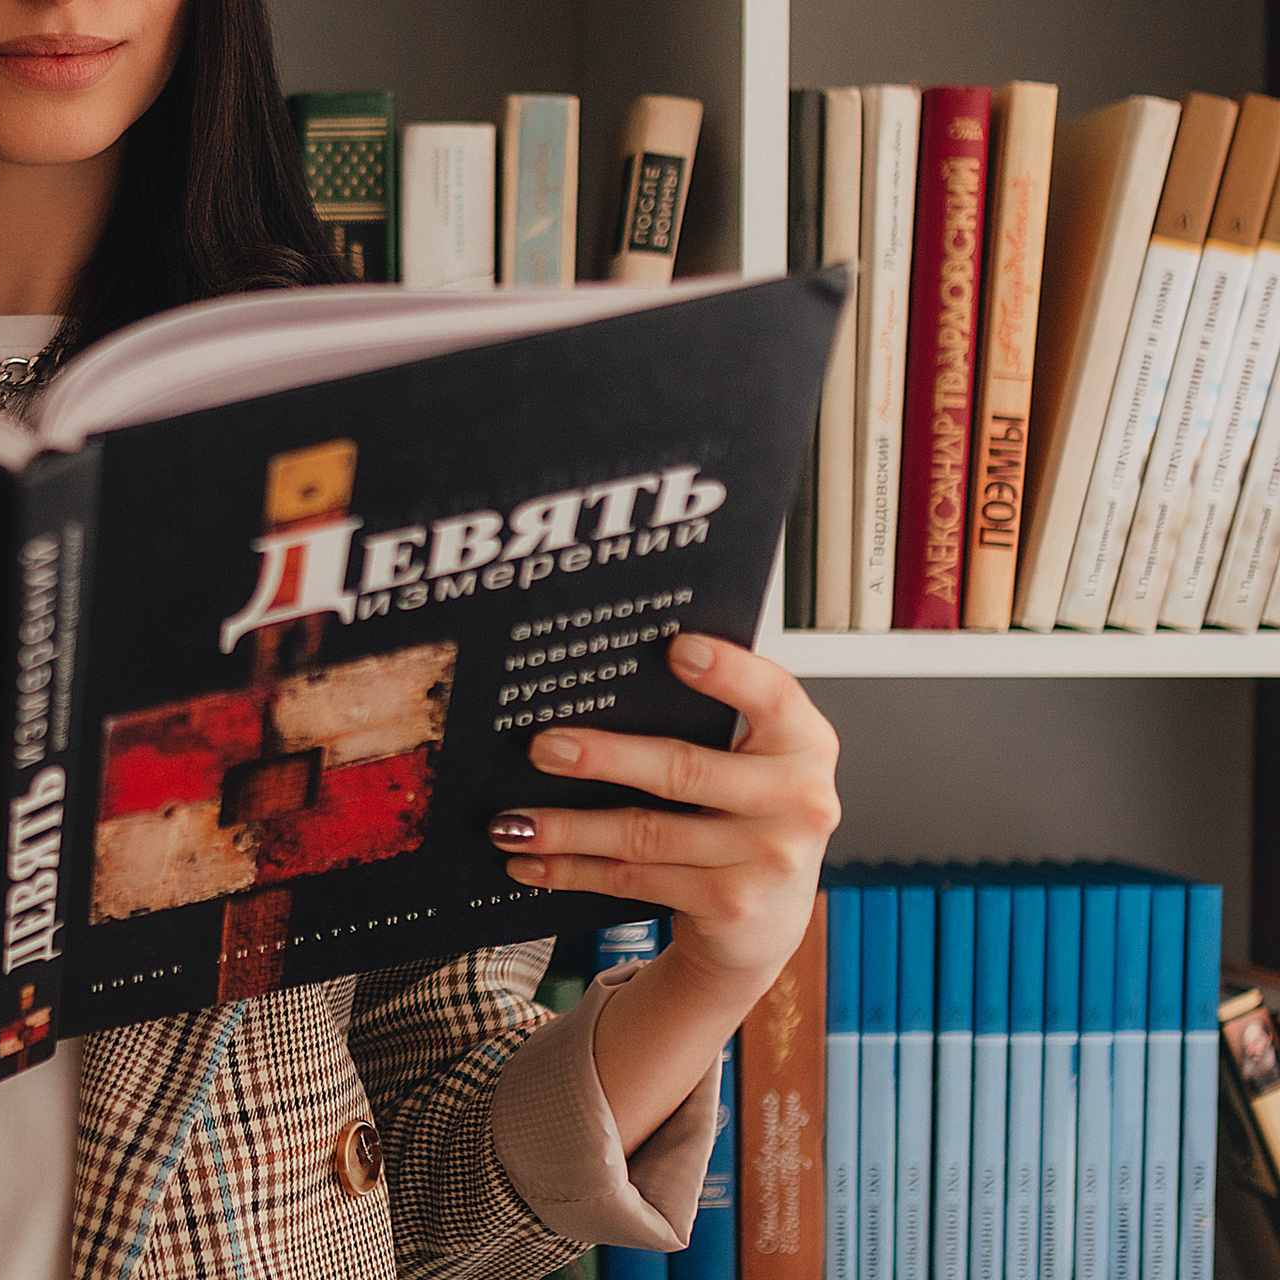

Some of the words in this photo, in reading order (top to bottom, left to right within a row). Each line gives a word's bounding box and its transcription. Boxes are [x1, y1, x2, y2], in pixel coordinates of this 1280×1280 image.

[631, 167, 662, 245] ПОСЛЕ
[652, 168, 680, 249] ВОЙНЫ
[932, 156, 980, 413] ТВАРДОВСКИЙ
[869, 435, 891, 570] Твардовский
[924, 416, 967, 604] АЛЕКСАНДР
[978, 414, 1025, 552] ПОЭМЫ
[354, 515, 713, 623] измерений
[508, 587, 695, 644] антология
[11, 532, 60, 771] измерений
[496, 657, 639, 707] русской
[504, 617, 681, 674] новейшей
[492, 692, 618, 732] поэзии
[1, 765, 66, 975] ДЕВЯТЬ
[90, 962, 184, 994] НОВОЕ
